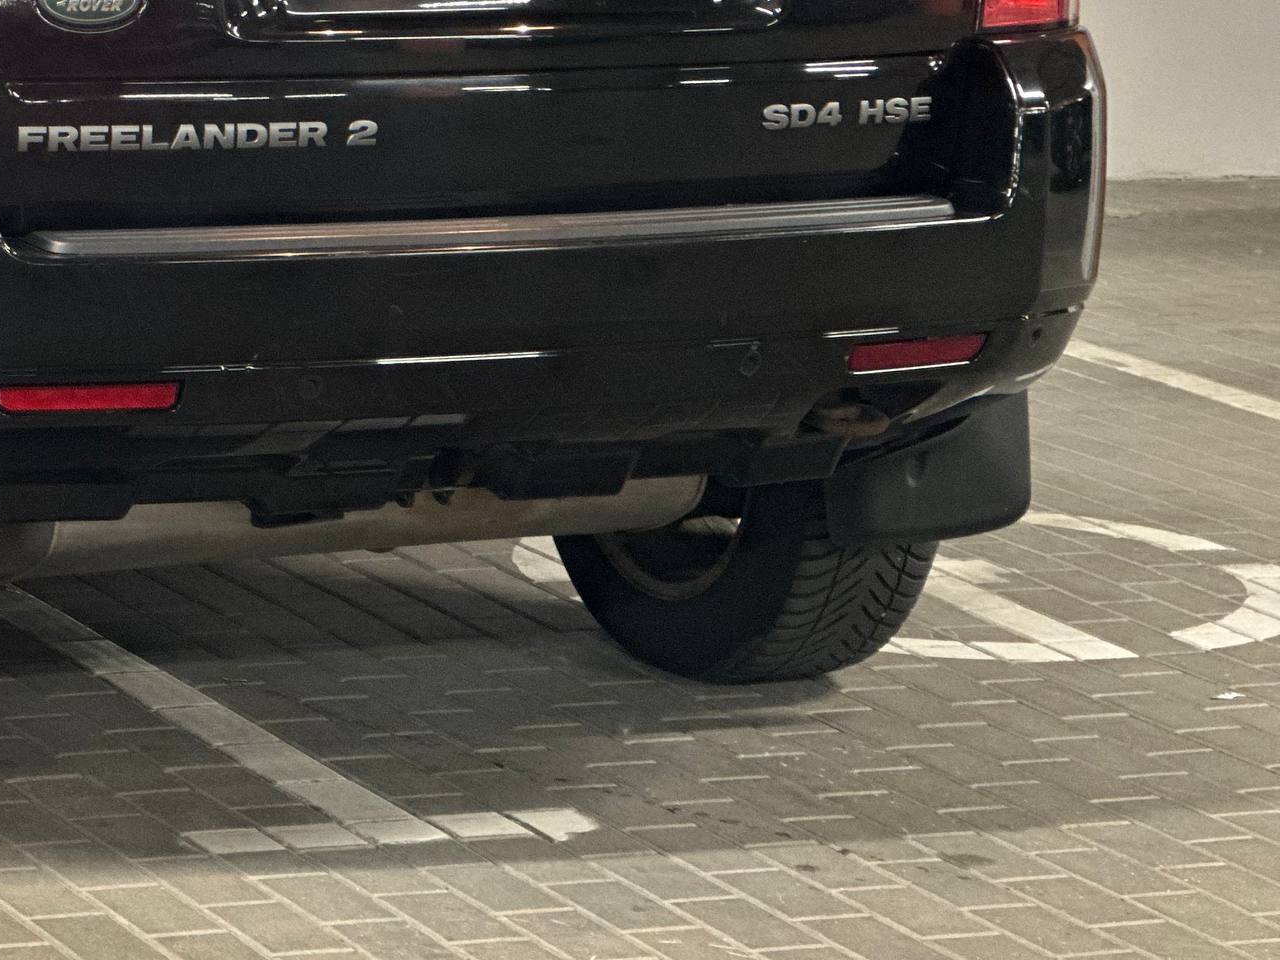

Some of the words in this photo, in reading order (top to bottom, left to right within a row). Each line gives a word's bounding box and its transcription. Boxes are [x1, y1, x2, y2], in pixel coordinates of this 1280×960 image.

[762, 101, 843, 130] SD4
[858, 96, 933, 125] HSE
[17, 120, 328, 152] FREELANDER
[346, 119, 379, 146] 2
